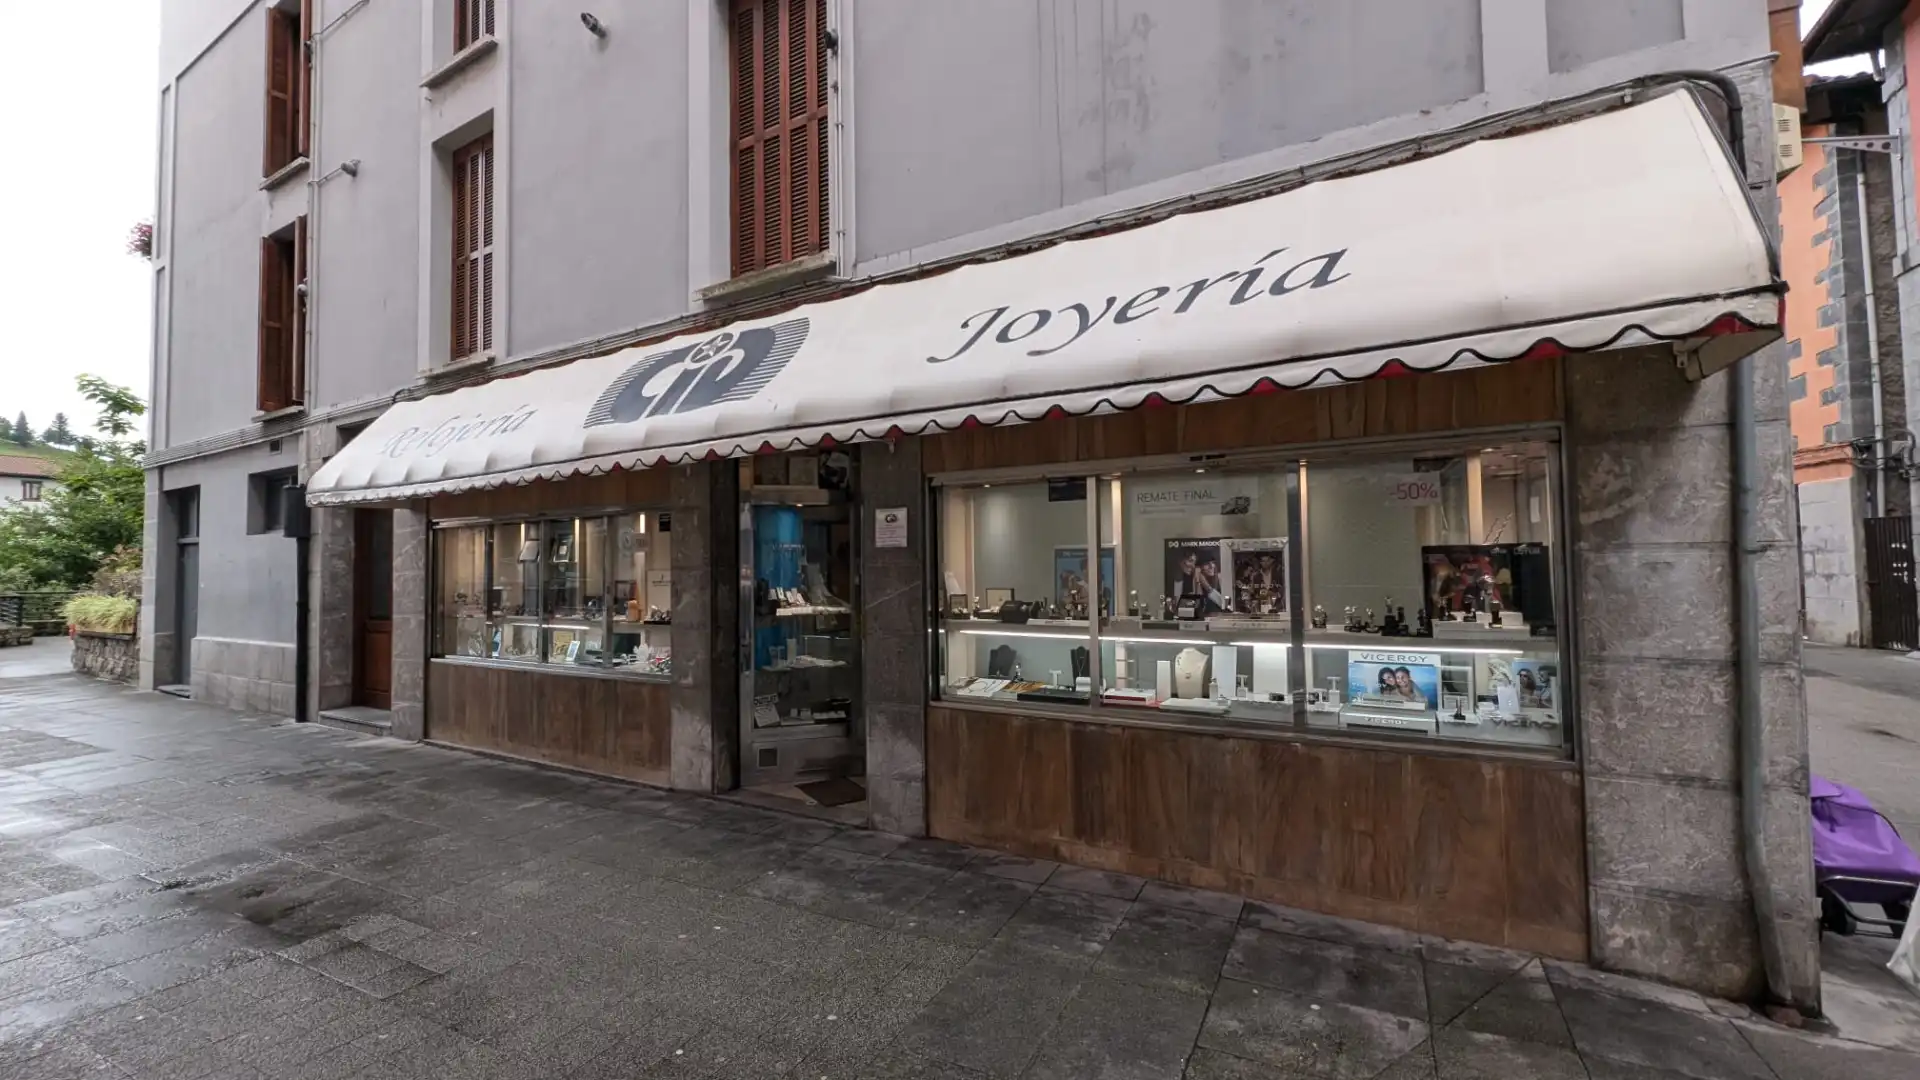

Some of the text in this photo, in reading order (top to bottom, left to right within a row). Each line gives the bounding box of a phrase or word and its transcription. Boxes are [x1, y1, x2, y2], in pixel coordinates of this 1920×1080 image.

[926, 246, 1351, 363] Joyería
[377, 403, 538, 458] Relojería
[1136, 489, 1216, 503] REMATE FINAL
[1389, 482, 1438, 500] -50%
[1361, 652, 1428, 662] VICEROY
